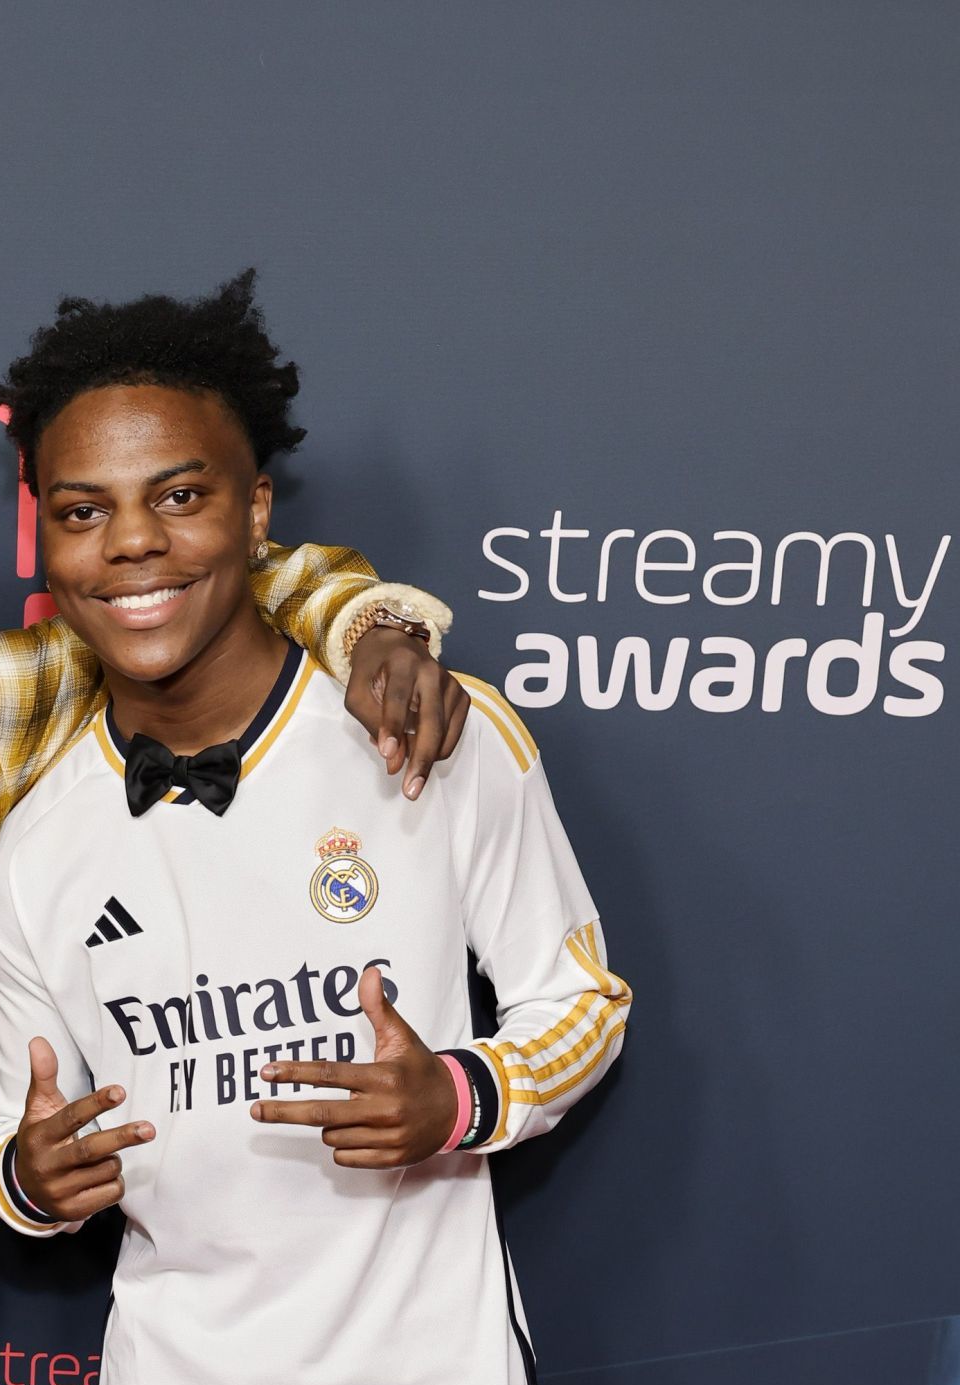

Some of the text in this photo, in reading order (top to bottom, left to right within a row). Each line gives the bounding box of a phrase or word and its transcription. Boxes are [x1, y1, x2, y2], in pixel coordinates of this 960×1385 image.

[477, 510, 951, 638] streamy
[504, 611, 946, 717] awards
[169, 1058, 196, 1113] FY
